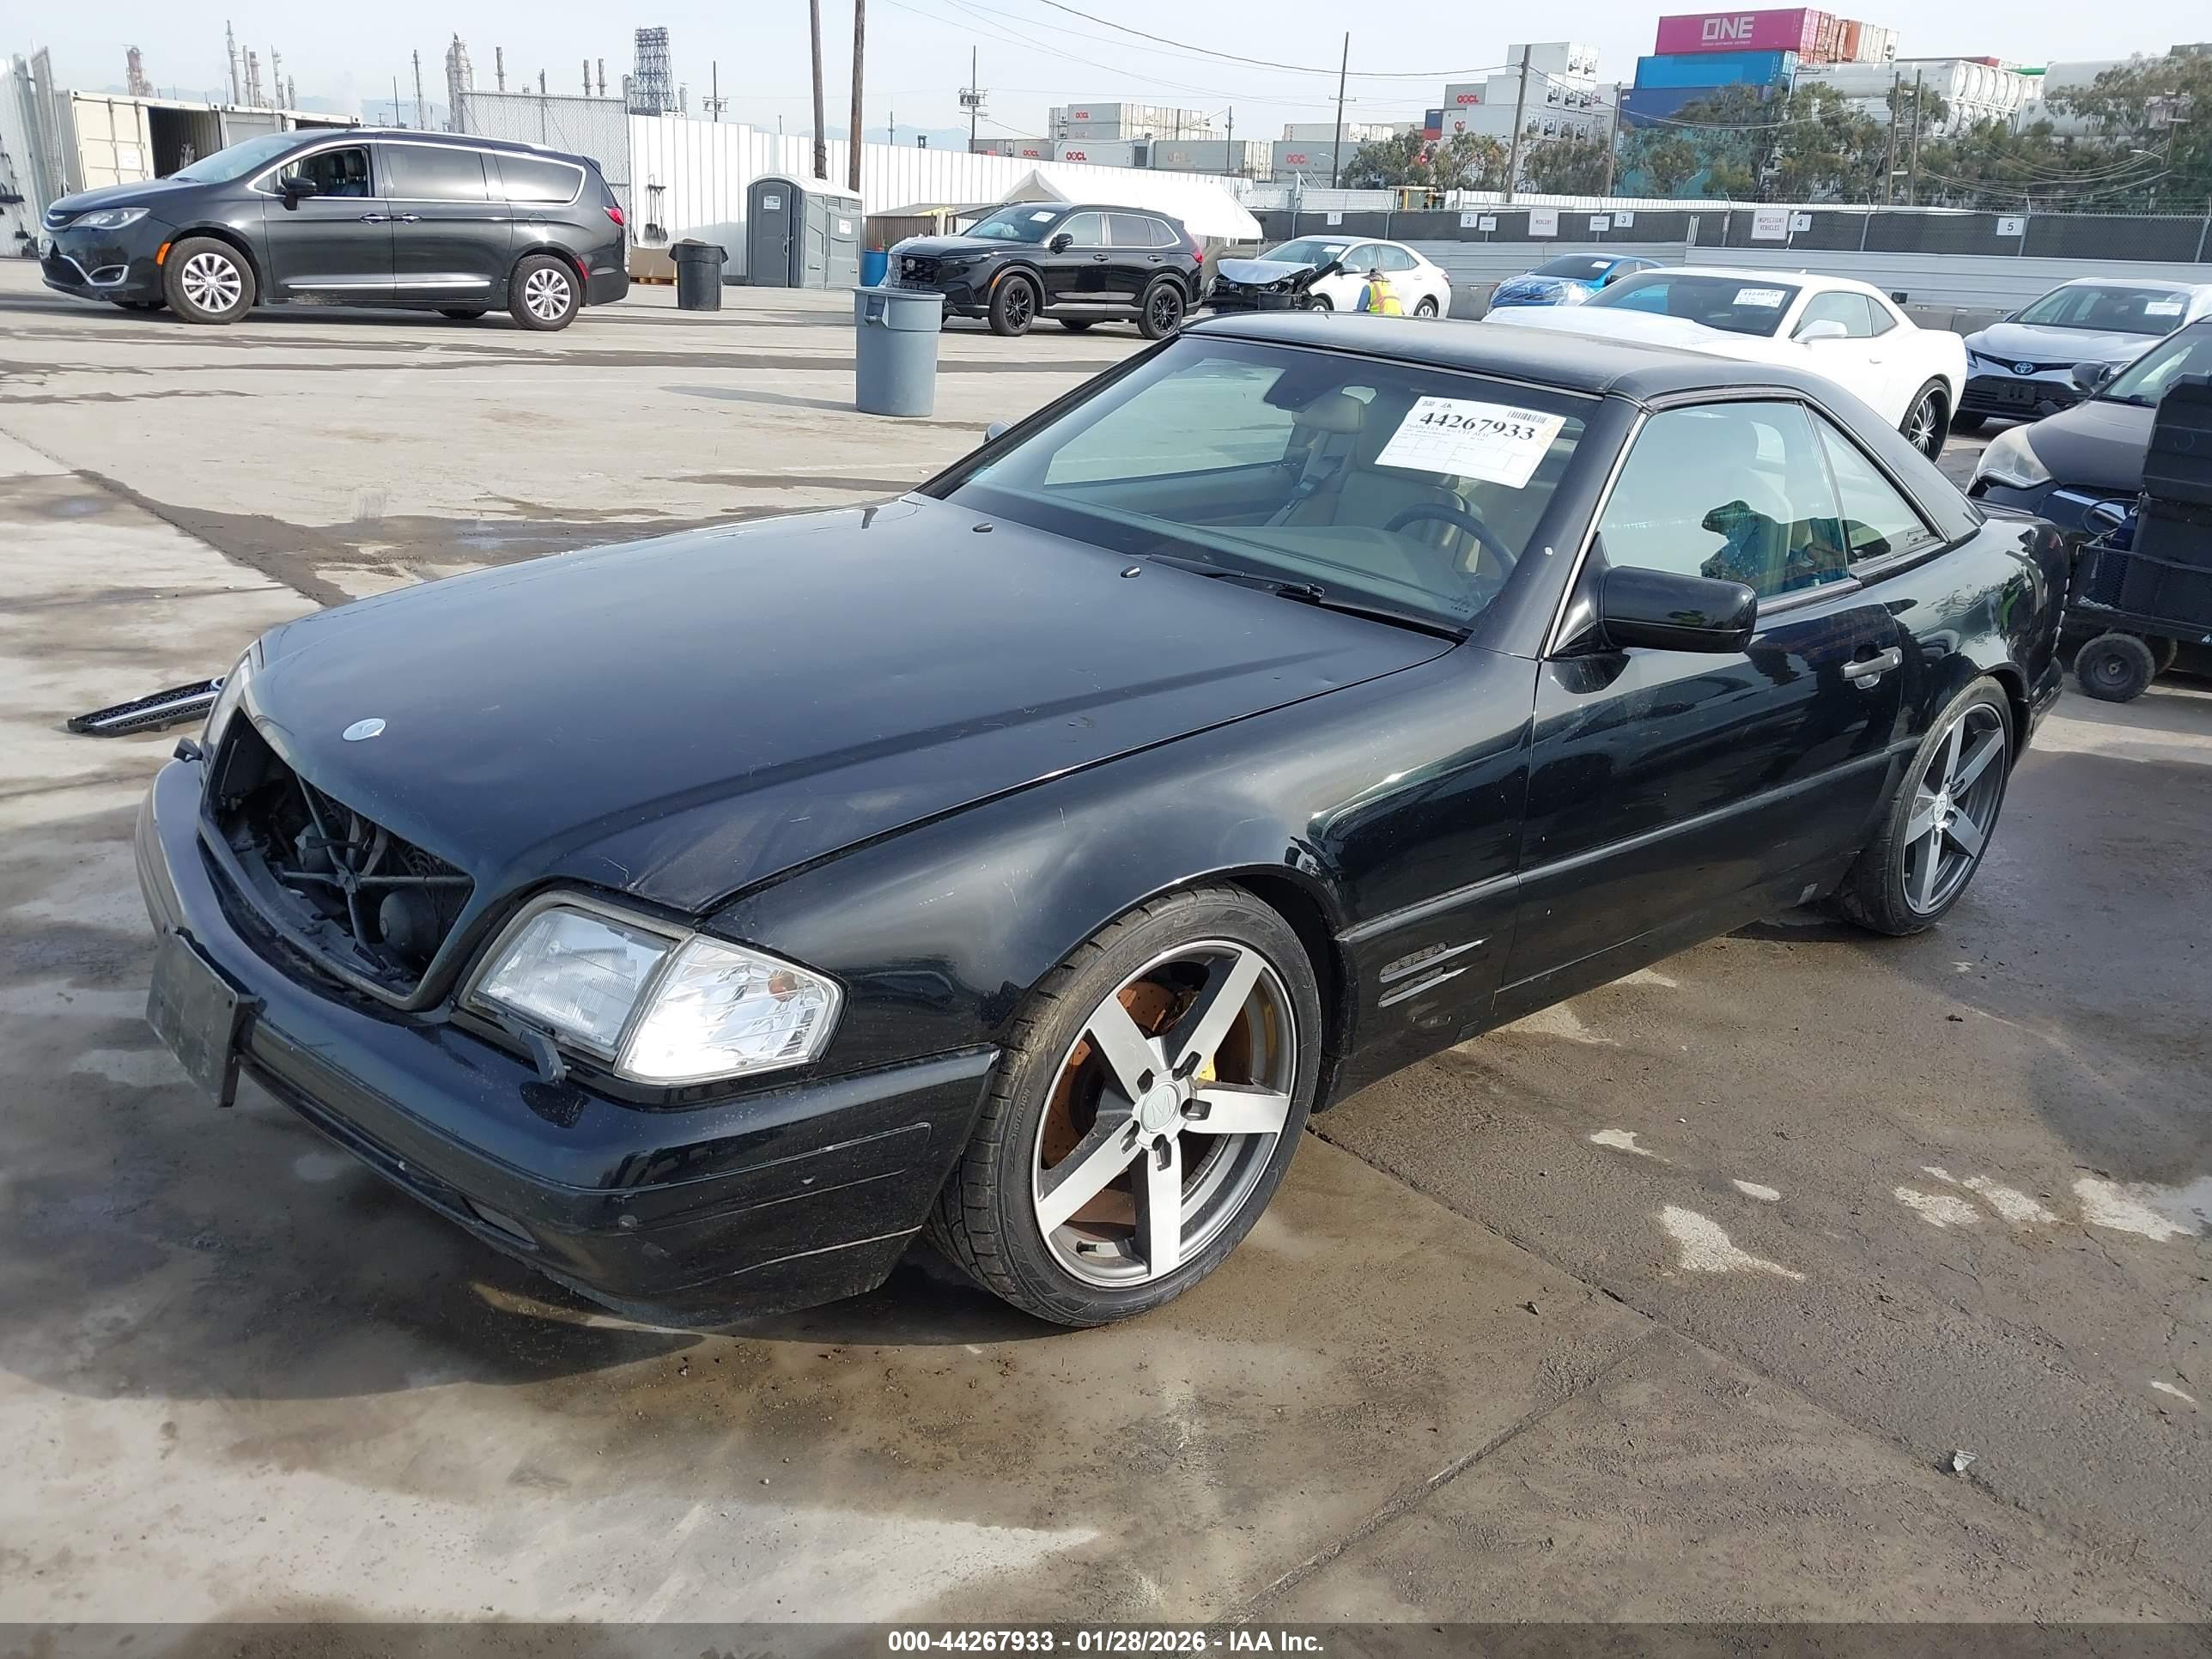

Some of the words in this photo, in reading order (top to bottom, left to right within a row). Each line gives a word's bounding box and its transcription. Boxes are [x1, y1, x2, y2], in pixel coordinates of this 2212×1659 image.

[1702, 16, 1755, 40] ONE
[1456, 94, 1479, 104] OOCL
[1066, 151, 1087, 161] OOCL
[1621, 216, 1627, 224] 3
[1796, 218, 1803, 228] 4
[2007, 222, 2014, 231] 5
[1419, 412, 1536, 441] 44267933
